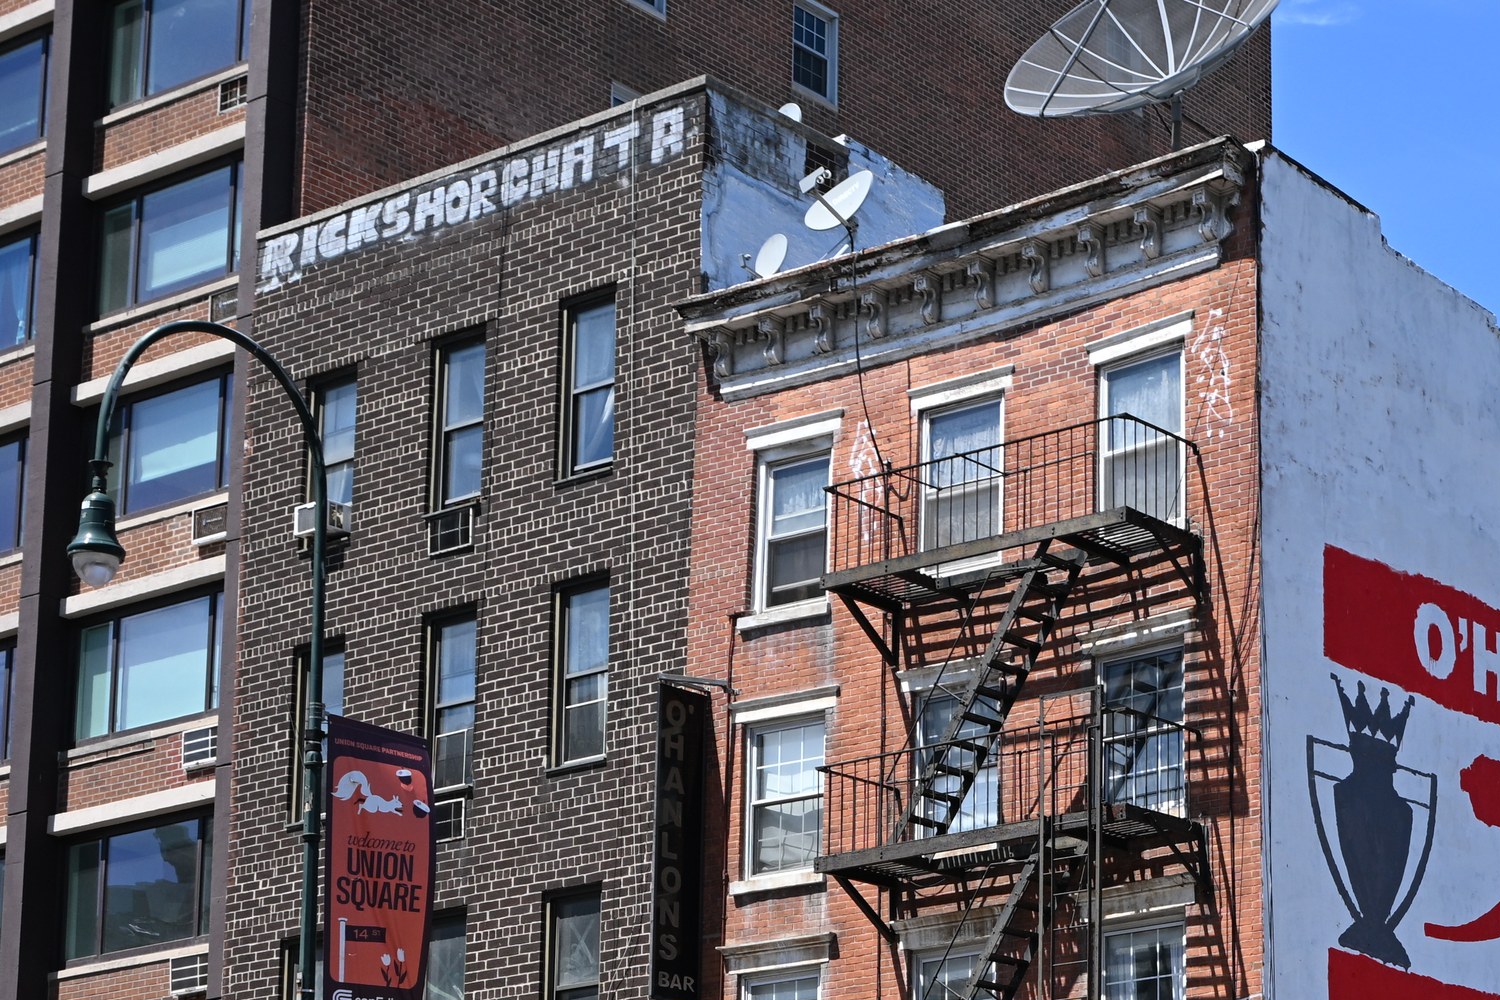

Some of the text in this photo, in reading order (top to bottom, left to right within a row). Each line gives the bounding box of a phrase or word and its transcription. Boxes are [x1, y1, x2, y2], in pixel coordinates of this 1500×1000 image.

[335, 738, 422, 761] UNION SQUARE PARTNERSHIP
[347, 831, 416, 853] welcome to
[347, 847, 414, 882] UNION
[336, 876, 423, 913] SQUARE
[353, 928, 369, 940] 14
[658, 971, 695, 993] BAR
